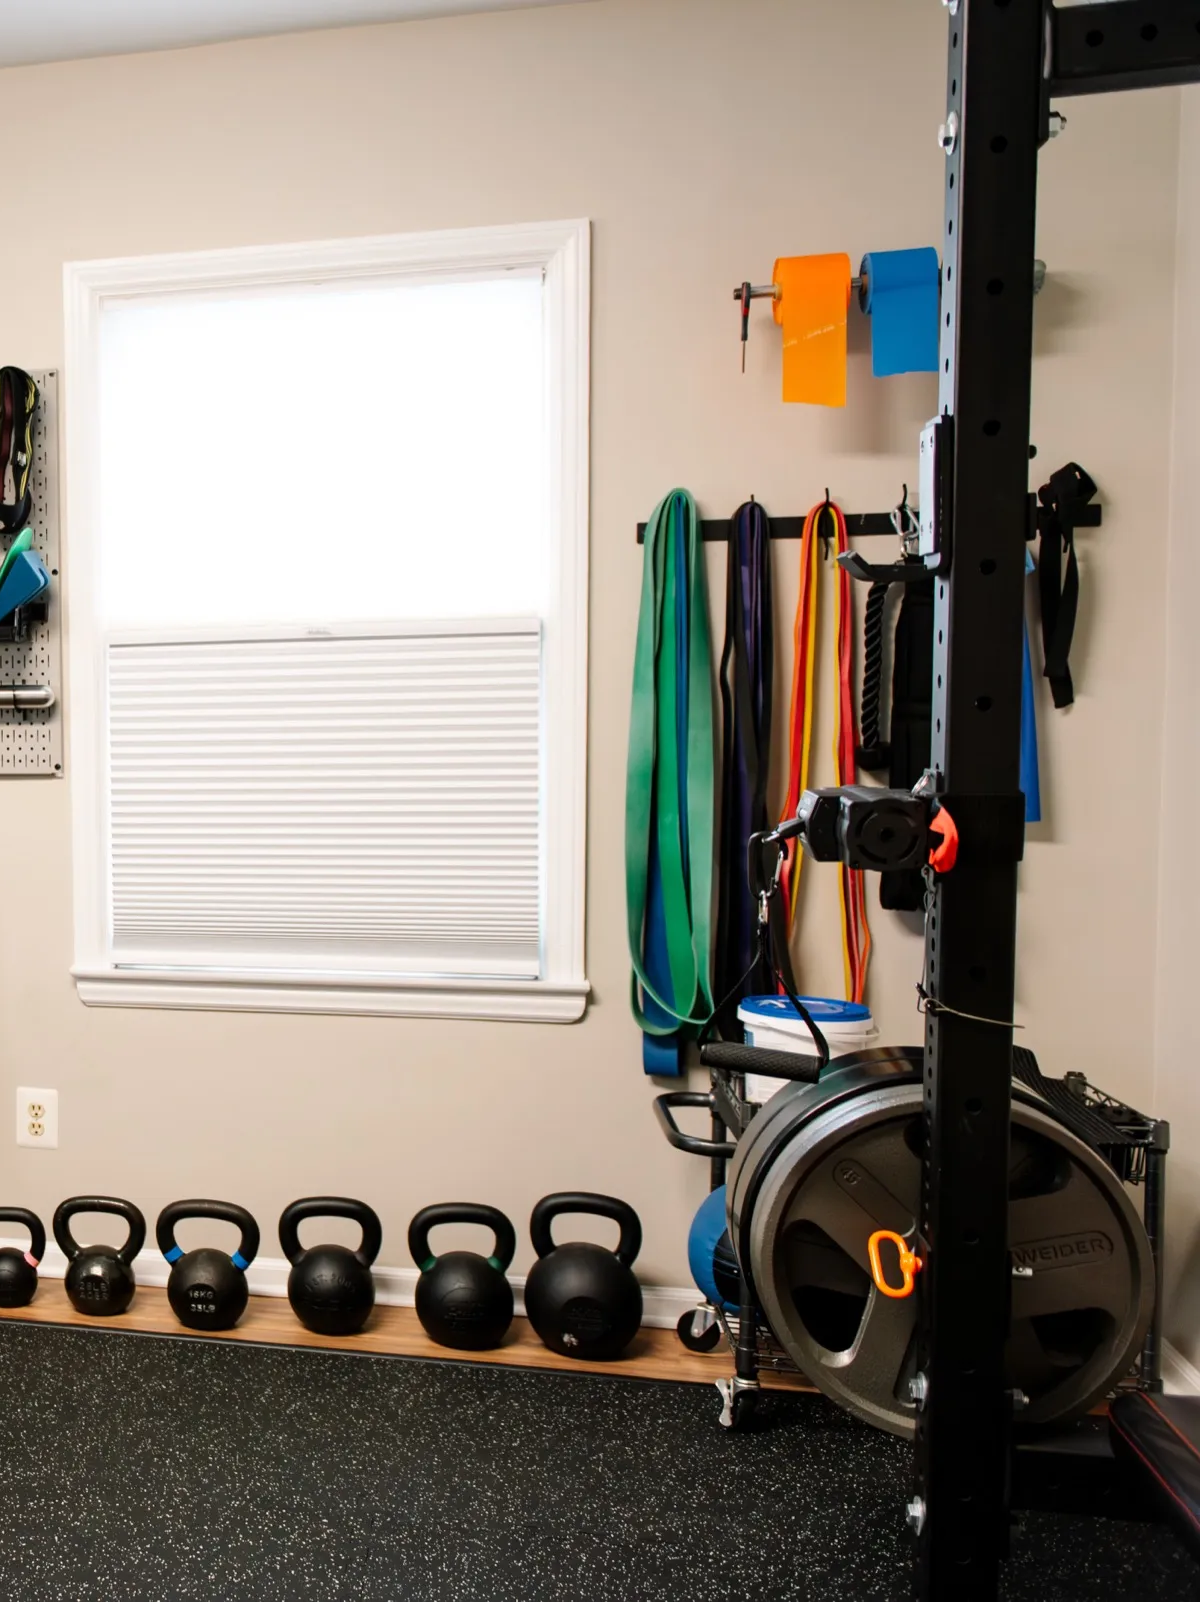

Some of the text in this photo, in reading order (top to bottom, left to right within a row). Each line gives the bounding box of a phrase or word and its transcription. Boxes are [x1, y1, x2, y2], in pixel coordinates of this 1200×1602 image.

[840, 1167, 862, 1186] 45
[1013, 1238, 1106, 1265] WEIDER
[188, 1290, 214, 1299] 16KG
